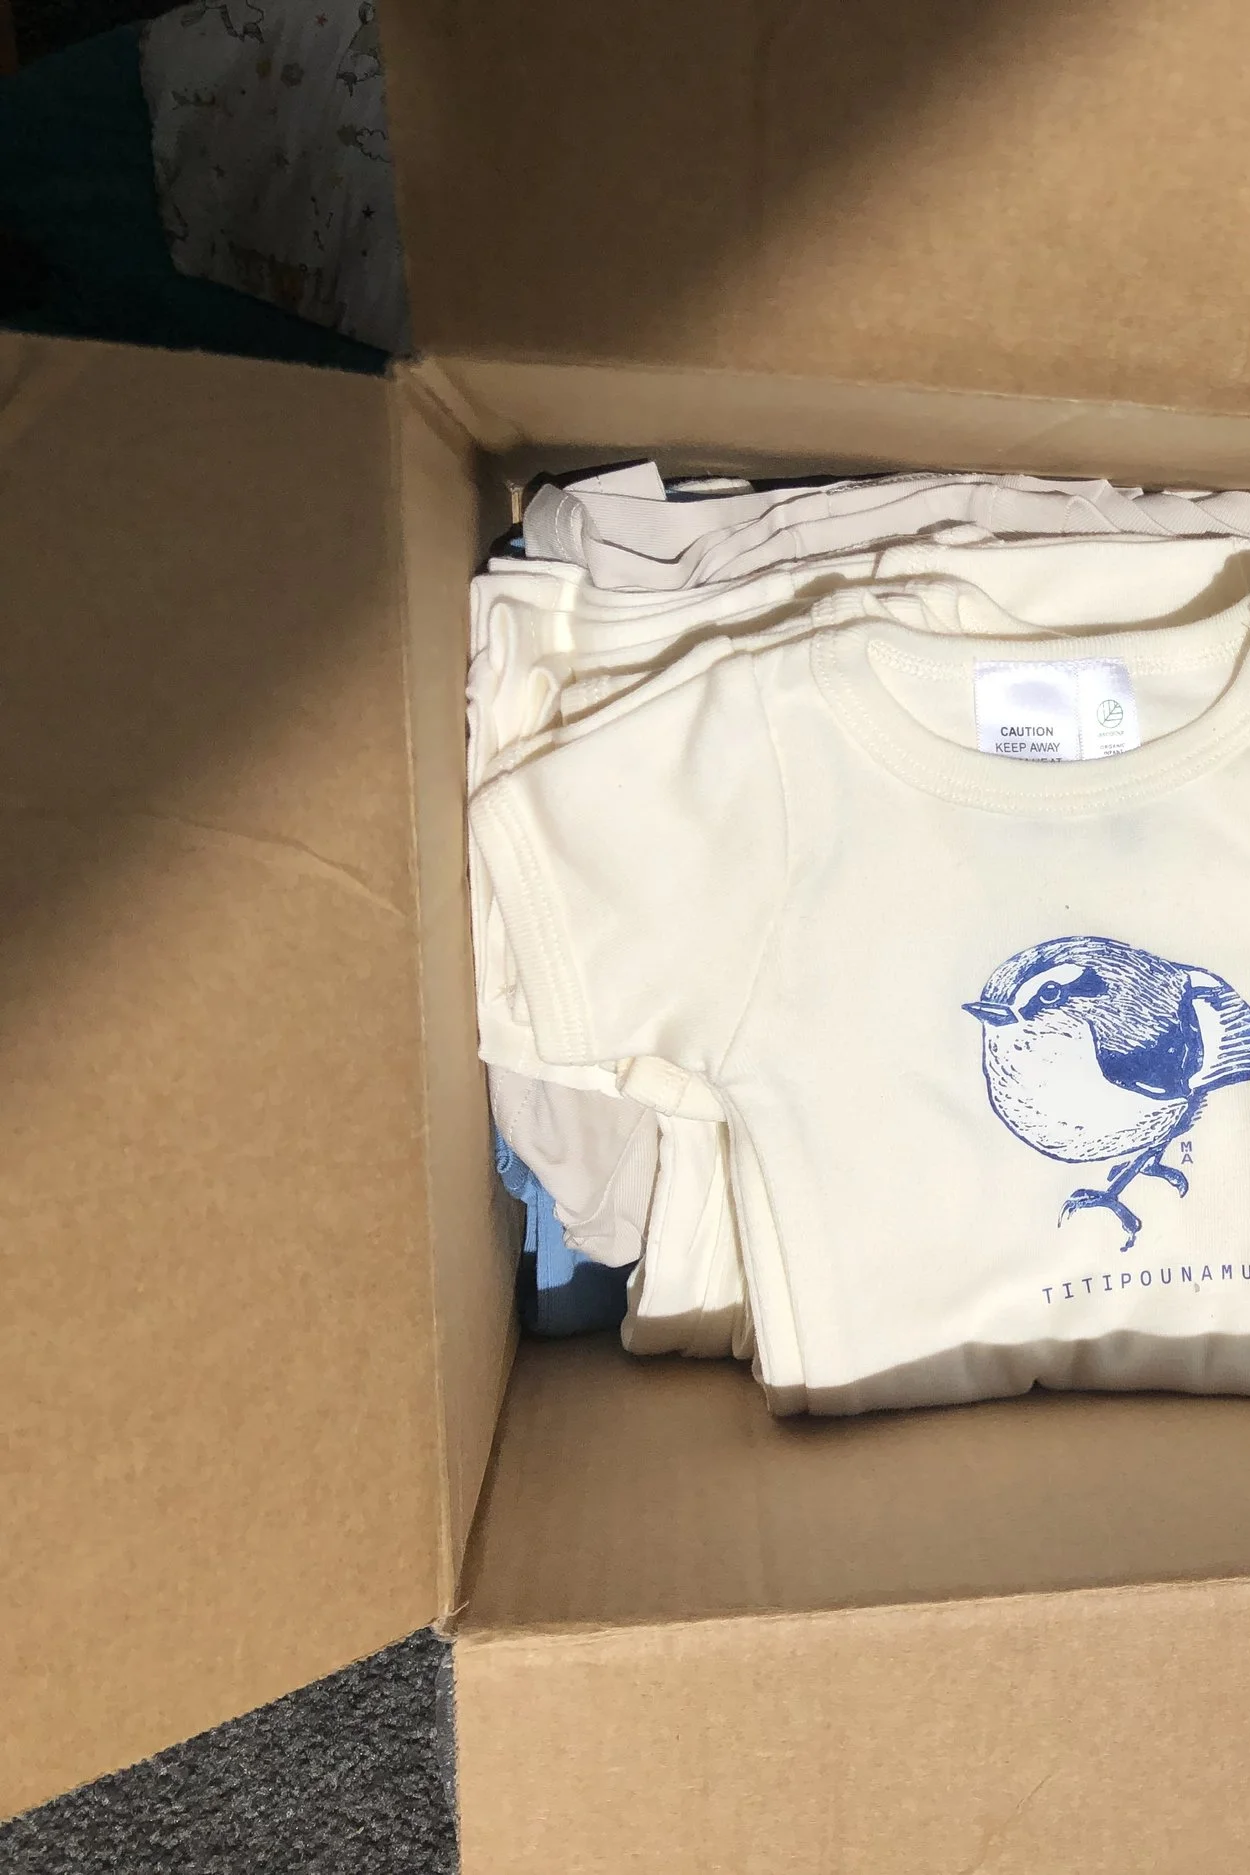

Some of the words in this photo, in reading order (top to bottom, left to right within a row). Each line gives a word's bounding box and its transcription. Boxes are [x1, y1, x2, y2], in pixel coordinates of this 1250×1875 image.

[1000, 726, 1054, 737] CAUTION
[995, 742, 1027, 753] KEEP
[1029, 742, 1061, 753] AWAY
